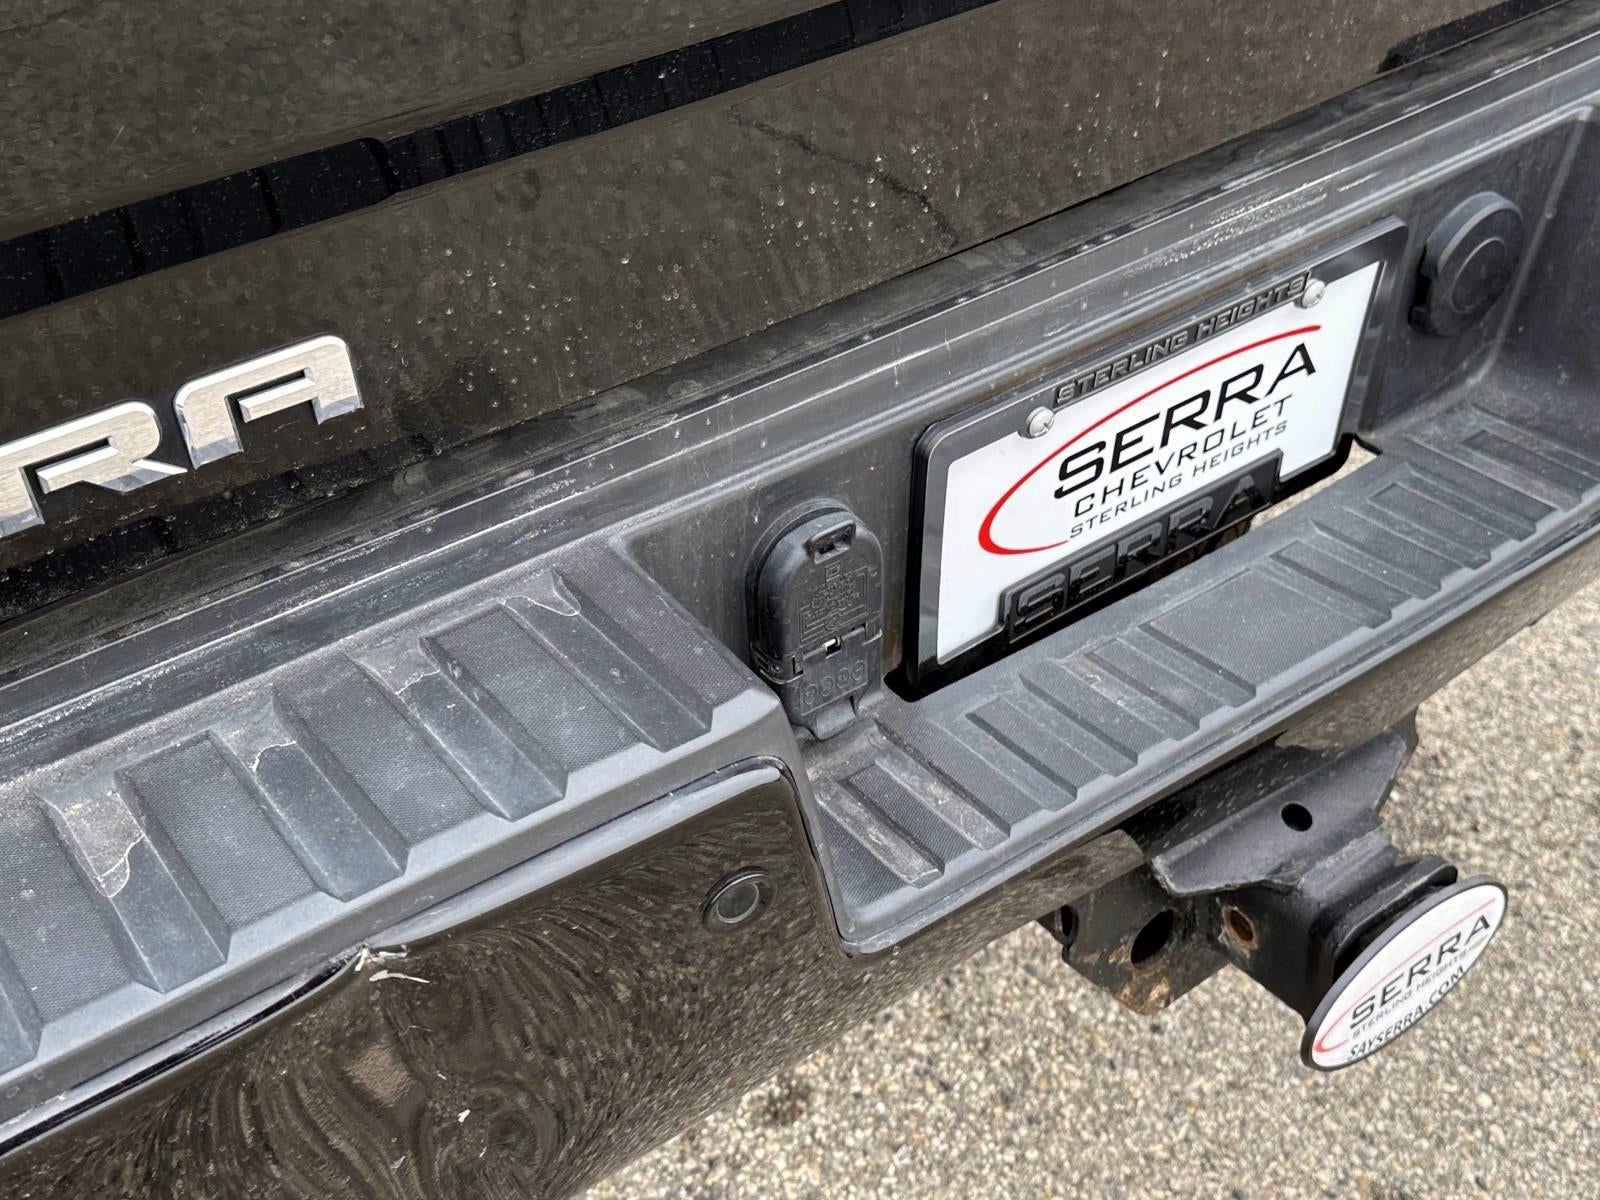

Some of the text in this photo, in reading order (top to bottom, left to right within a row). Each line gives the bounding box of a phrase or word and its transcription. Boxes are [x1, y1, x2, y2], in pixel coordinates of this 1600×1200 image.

[1057, 275, 1305, 404] STERLING HEIGHTS
[1054, 343, 1316, 499] SERRA
[1070, 420, 1287, 539] STERLING HEIGHTS
[1074, 394, 1292, 518] CHEVROLET
[1014, 474, 1271, 627] SERRA
[1350, 914, 1490, 1029] SERRA
[1350, 965, 1464, 1056] SAYSERRA.COM
